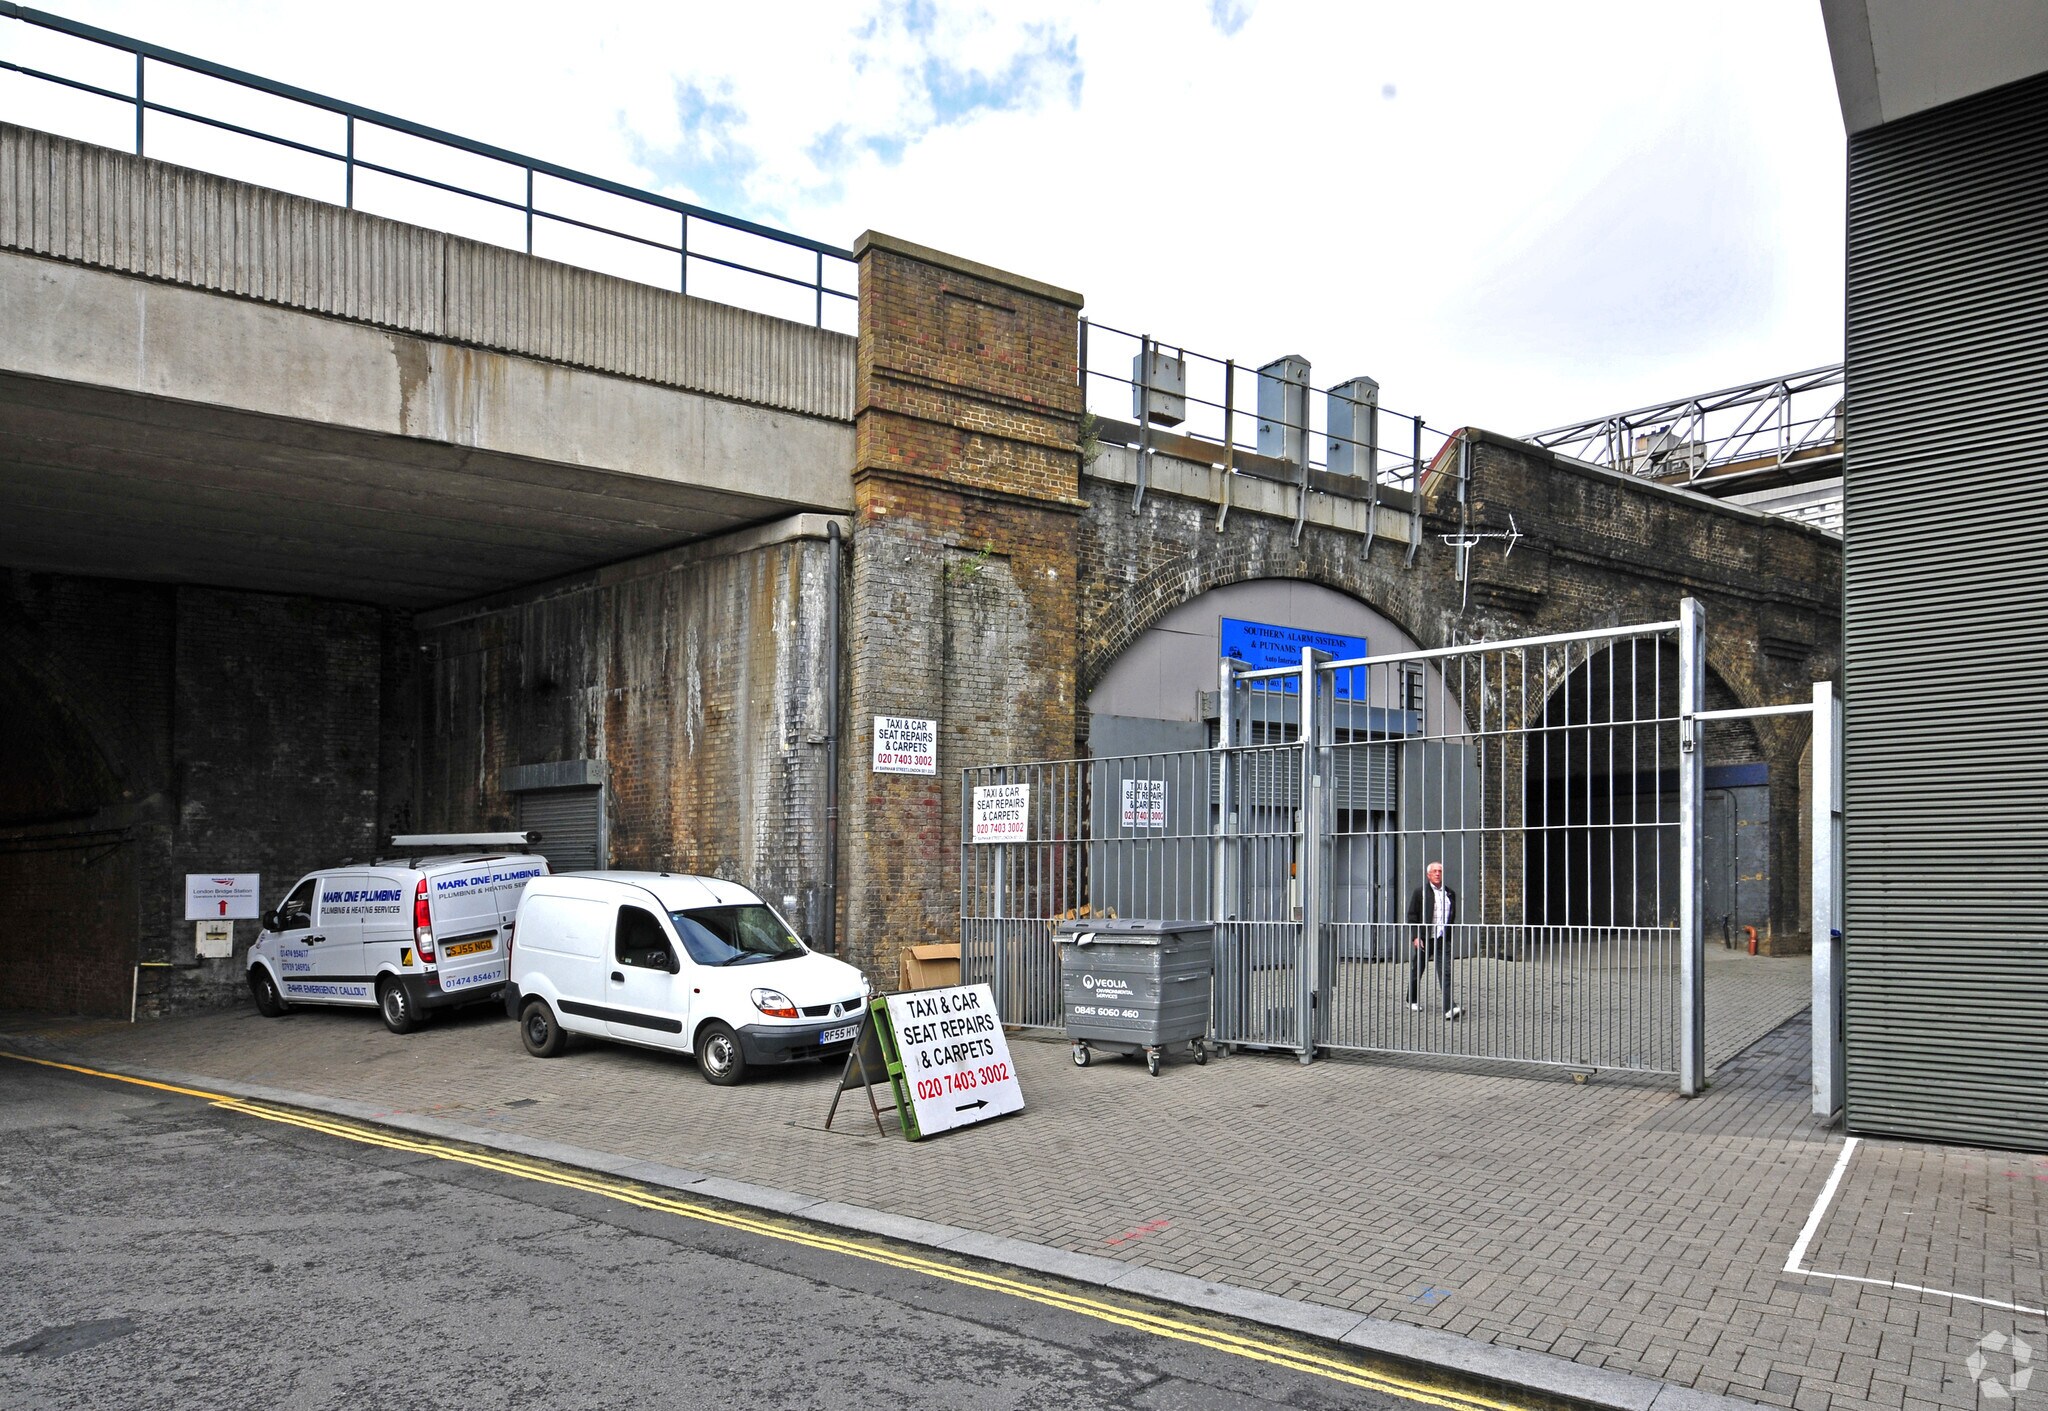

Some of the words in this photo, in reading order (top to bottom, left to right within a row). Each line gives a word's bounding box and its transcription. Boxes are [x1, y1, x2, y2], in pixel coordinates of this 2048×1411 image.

[1243, 626, 1284, 638] SOUTHERN
[1288, 633, 1313, 643] ALARM
[1315, 637, 1347, 647] SYSTEMS
[1260, 641, 1296, 653] PUTNAMS
[1278, 656, 1298, 665] Interior
[886, 718, 903, 729] TAXI
[904, 720, 909, 730] &
[911, 720, 927, 731] CAR
[878, 728, 898, 740] SEAT
[900, 730, 933, 742] REPAIRS
[885, 740, 891, 750] &
[892, 741, 927, 753] CARPETS
[878, 753, 892, 764] 020
[894, 754, 912, 764] 7403
[914, 755, 932, 766] 3002
[983, 788, 998, 798] TAXI
[998, 788, 1003, 798] &
[1005, 787, 1019, 797] CAR
[1130, 782, 1142, 791] TXI
[1144, 782, 1148, 791] &
[1126, 790, 1141, 800] SET
[977, 800, 994, 810] SEAT
[995, 798, 1025, 809] REPAIRS
[1136, 800, 1161, 809] CARETS
[982, 811, 987, 821] &
[988, 810, 1020, 821] CARPETS
[977, 824, 988, 834] 020
[990, 823, 1006, 833] 7403
[1008, 822, 1024, 832] 3002
[437, 879, 468, 891] MARK
[470, 875, 490, 886] ONE
[492, 868, 540, 882] PLUMBING
[322, 891, 343, 903] MARK
[344, 891, 360, 902] ONE
[360, 890, 402, 901] PLUMBING
[438, 888, 476, 900] PLUMBING
[484, 883, 513, 893] HEATING
[321, 906, 346, 914] PLUMBING
[351, 906, 373, 914] HEATING
[374, 905, 400, 914] SERVICES
[450, 943, 474, 956] SJ55
[445, 976, 471, 988] 01474
[473, 971, 501, 983] 854617
[1094, 979, 1127, 988] VEOLIA
[287, 983, 303, 992] 24HR
[304, 984, 338, 995] EMERGENCY
[339, 986, 367, 996] CALLOUT
[906, 998, 938, 1018] TAXI
[940, 996, 951, 1014] &
[952, 992, 980, 1012] CAR
[1074, 1005, 1096, 1015] 0845
[1097, 1007, 1120, 1017] 6060
[1121, 1009, 1139, 1019] 460
[824, 1029, 845, 1041] RF55
[903, 1022, 937, 1045] SEAT
[940, 1014, 994, 1039] REPAIRS
[921, 1050, 932, 1069] &
[933, 1038, 994, 1066] CARPETS
[917, 1077, 943, 1100] 020
[944, 1070, 977, 1093] 7403
[978, 1063, 1009, 1085] 3002
